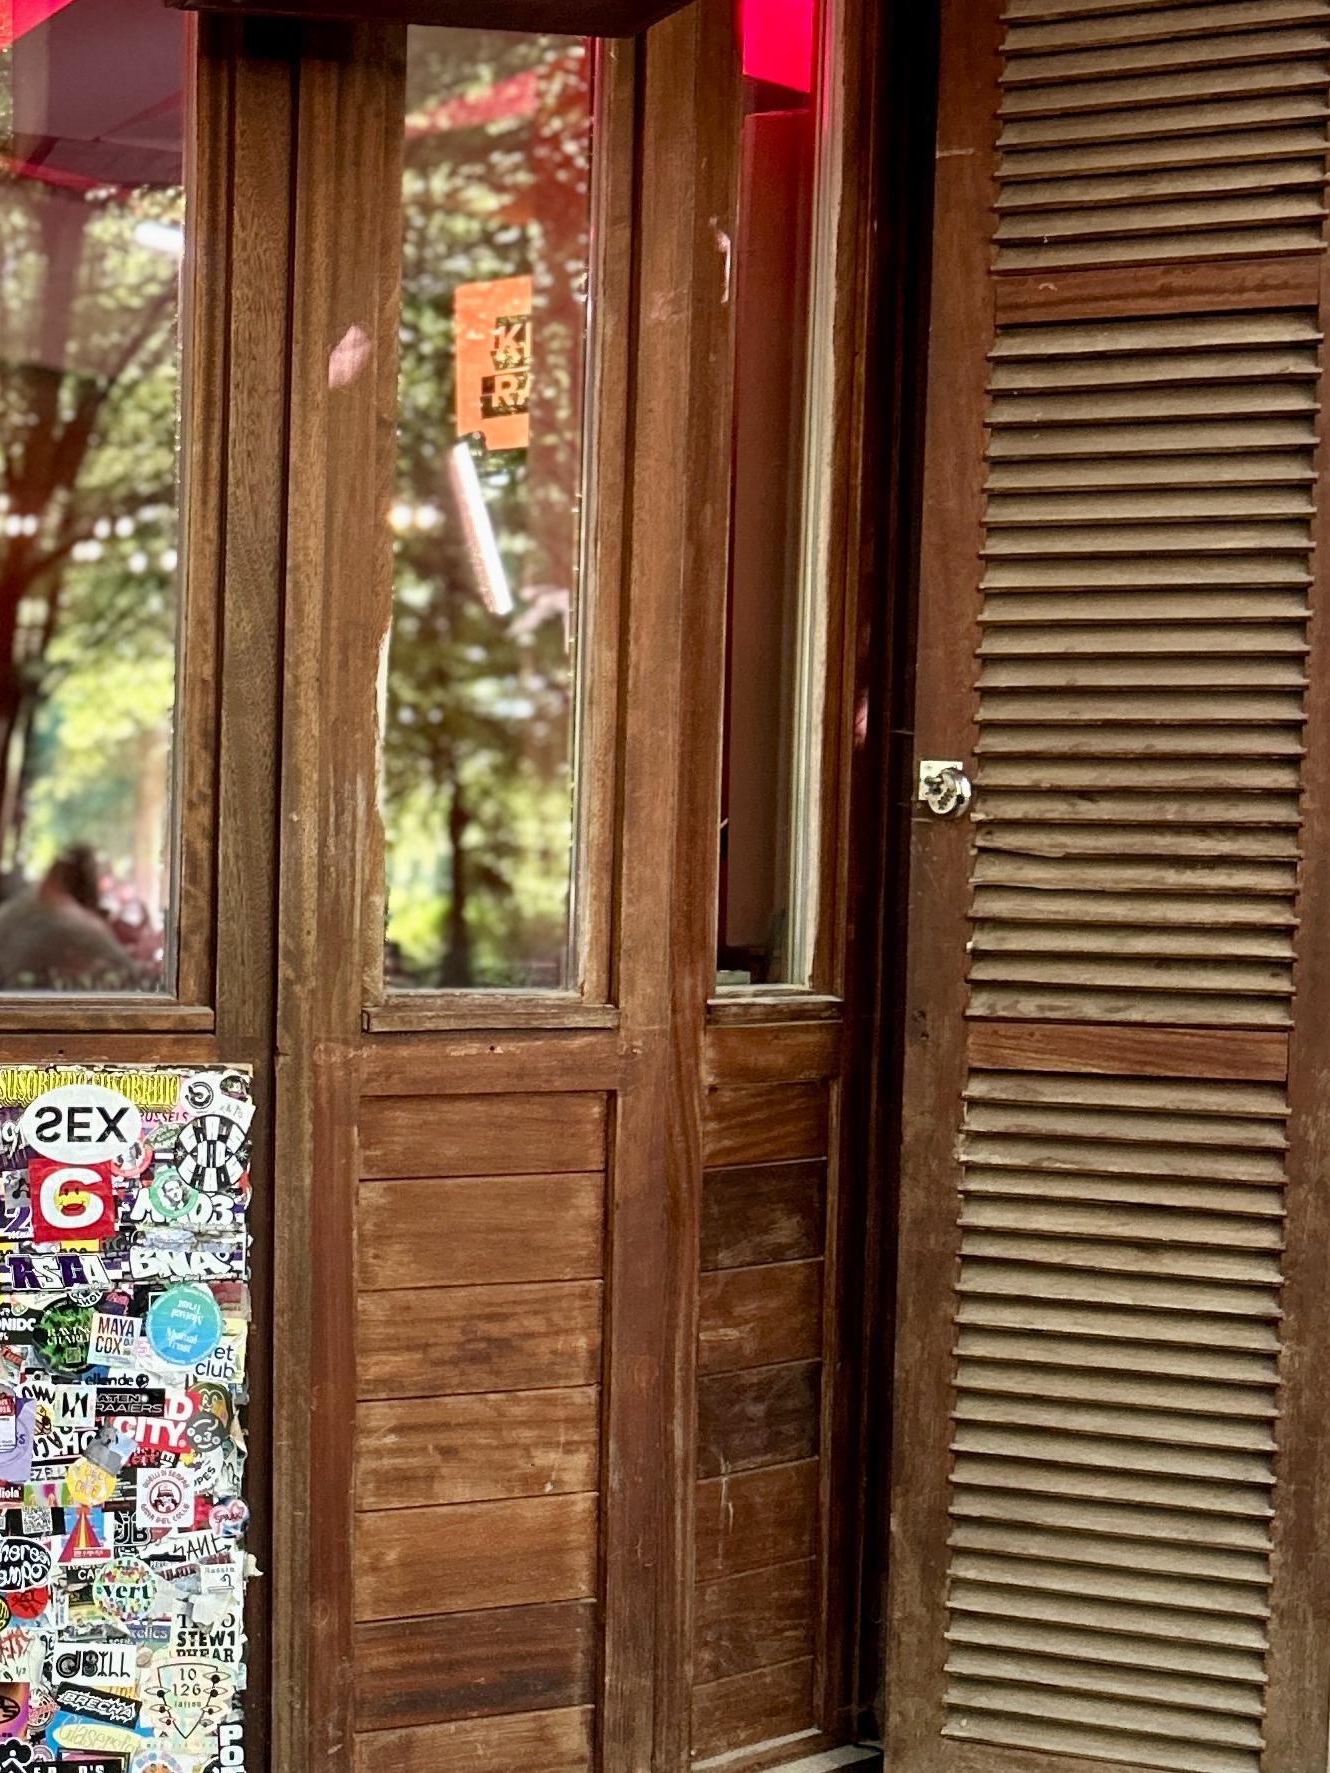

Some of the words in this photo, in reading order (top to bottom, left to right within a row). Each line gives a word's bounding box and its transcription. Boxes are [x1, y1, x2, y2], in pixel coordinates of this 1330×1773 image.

[35, 1106, 130, 1142] SEX
[98, 1317, 135, 1337] MAYA
[95, 1336, 122, 1354] COX
[195, 1360, 235, 1379] club
[103, 1584, 151, 1600] vert
[179, 1668, 197, 1681] 10
[172, 1684, 201, 1696] 126
